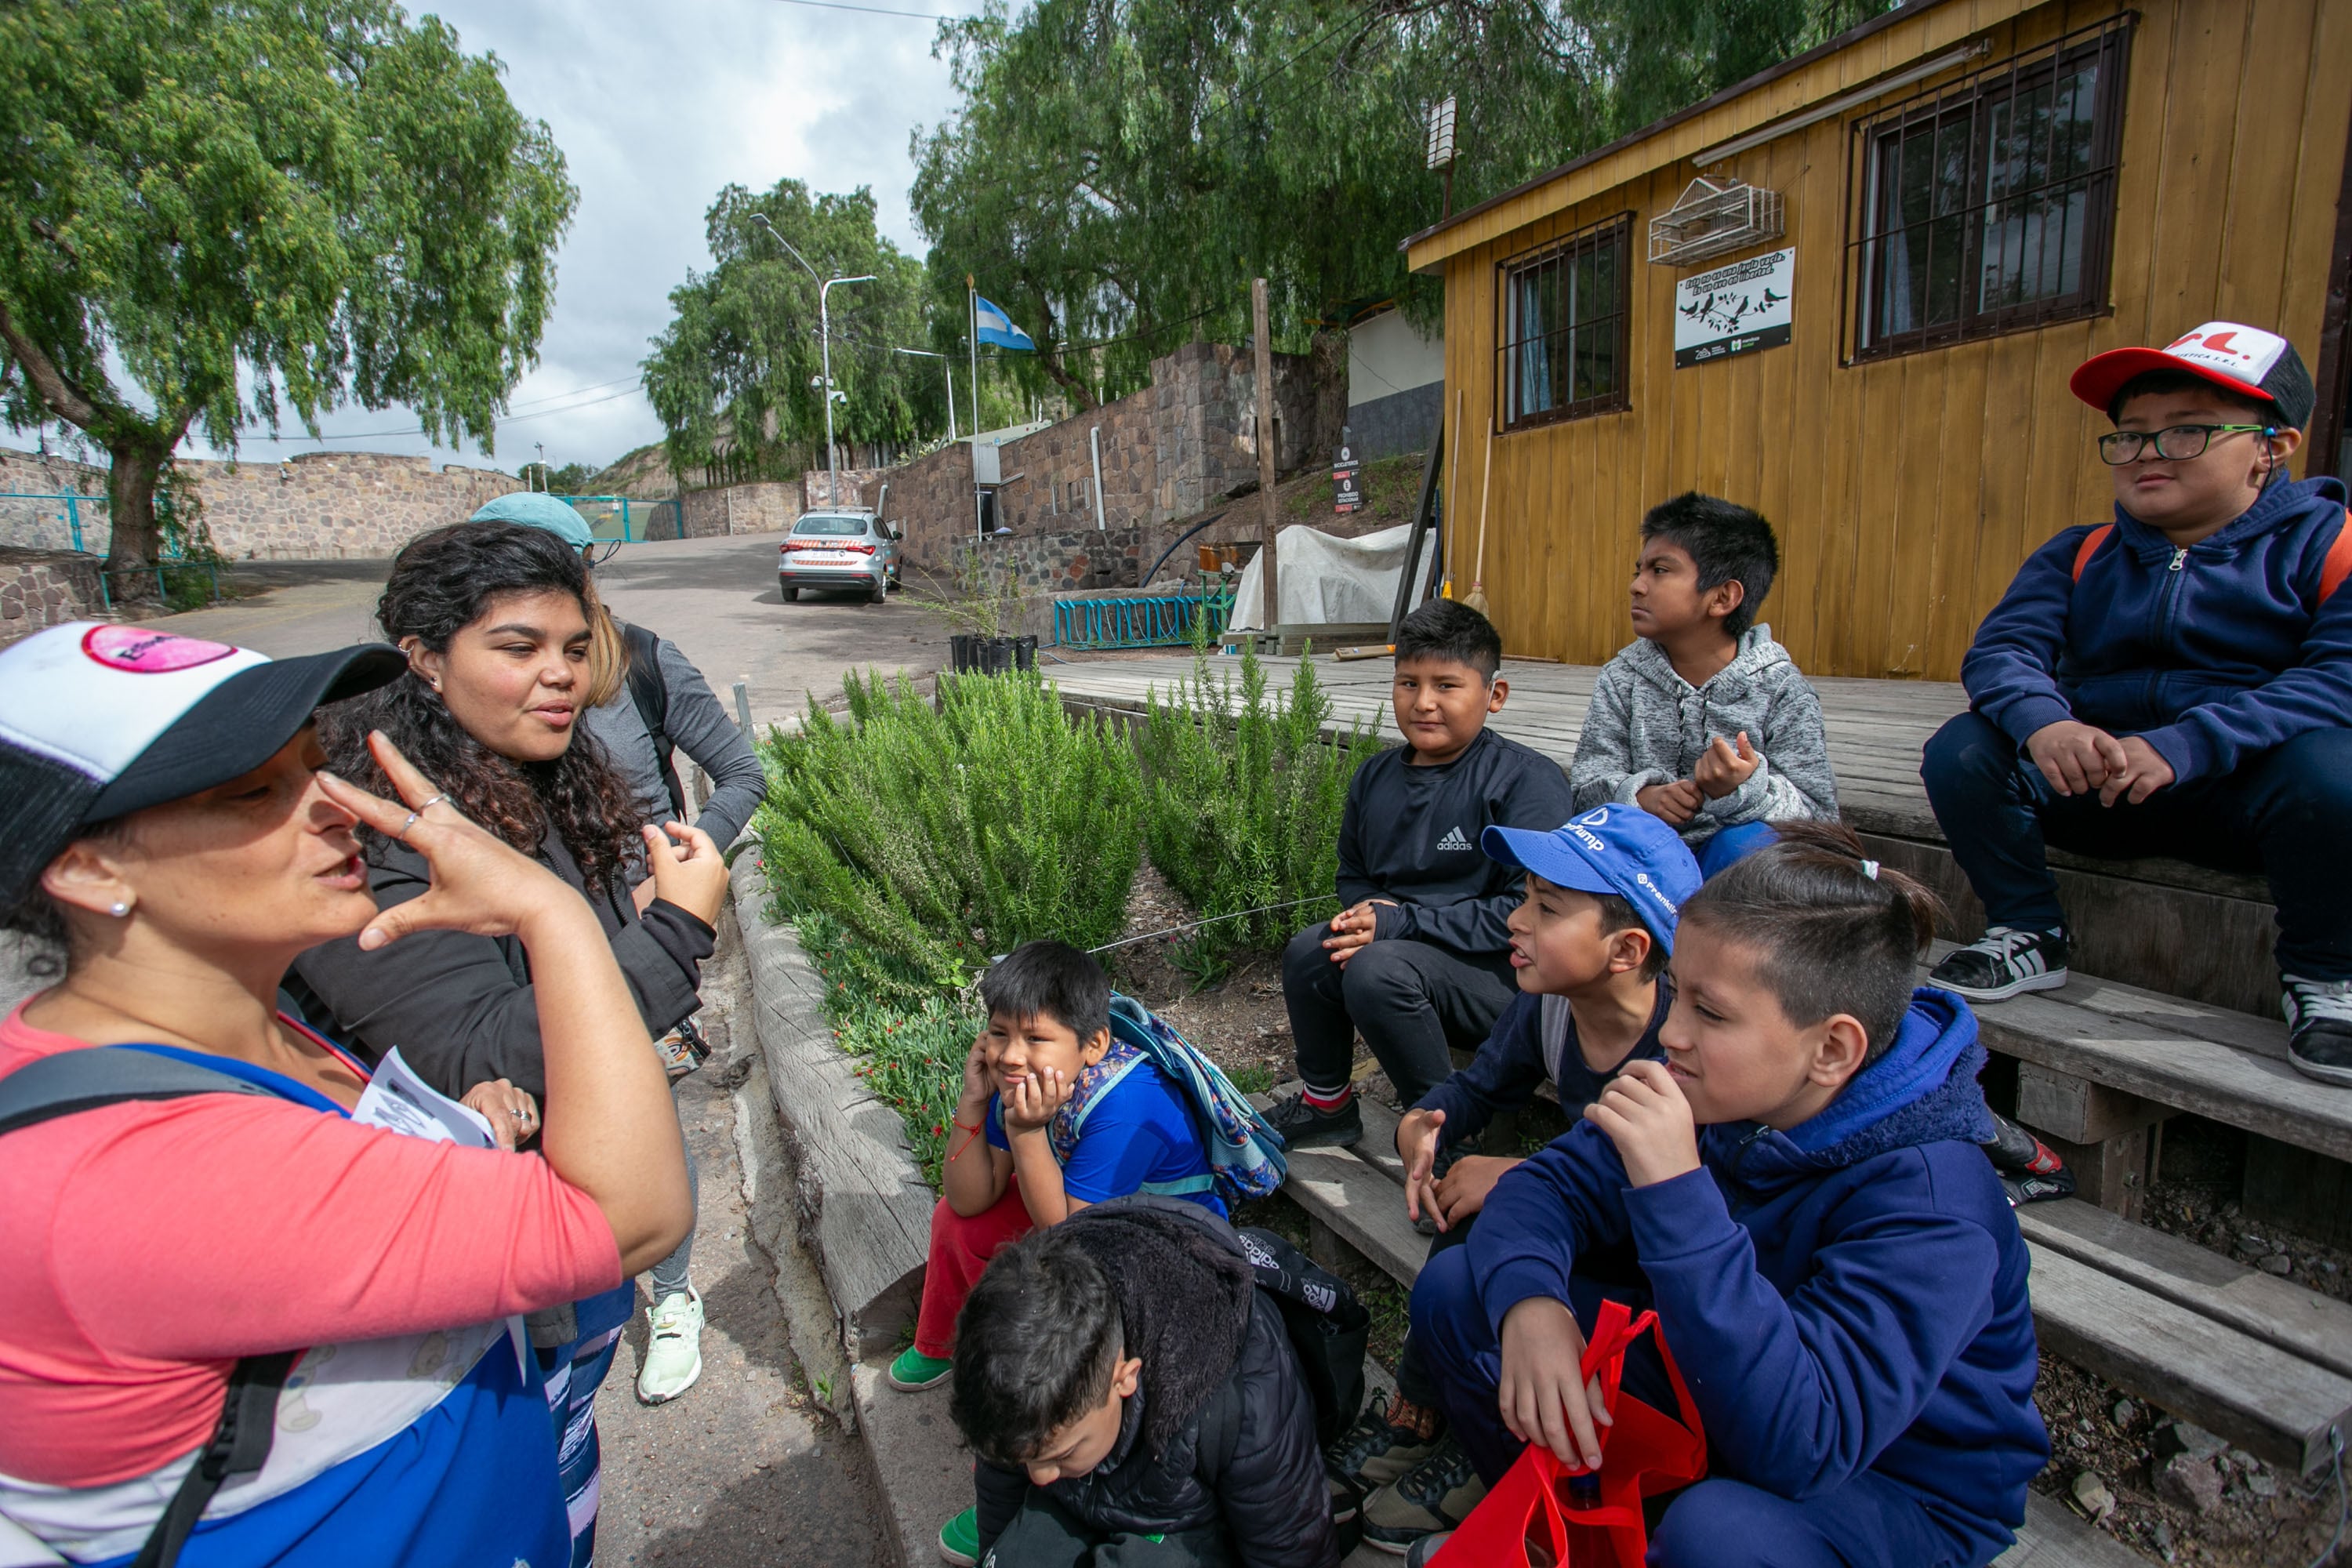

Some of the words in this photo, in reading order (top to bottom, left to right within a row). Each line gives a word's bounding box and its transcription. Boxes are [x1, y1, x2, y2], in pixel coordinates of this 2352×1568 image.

[1685, 277, 1700, 289] Esta
[1701, 274, 1711, 284] no
[1711, 271, 1722, 281] es
[1722, 267, 1737, 278] una
[1737, 260, 1759, 275] jaula
[1693, 285, 1702, 296] Es
[1702, 283, 1713, 293] un
[1713, 279, 1727, 290] ave
[1728, 275, 1739, 285] en
[1739, 263, 1774, 282] libertad.
[1436, 840, 1472, 851] adidas
[1239, 1235, 1280, 1269] adidas
